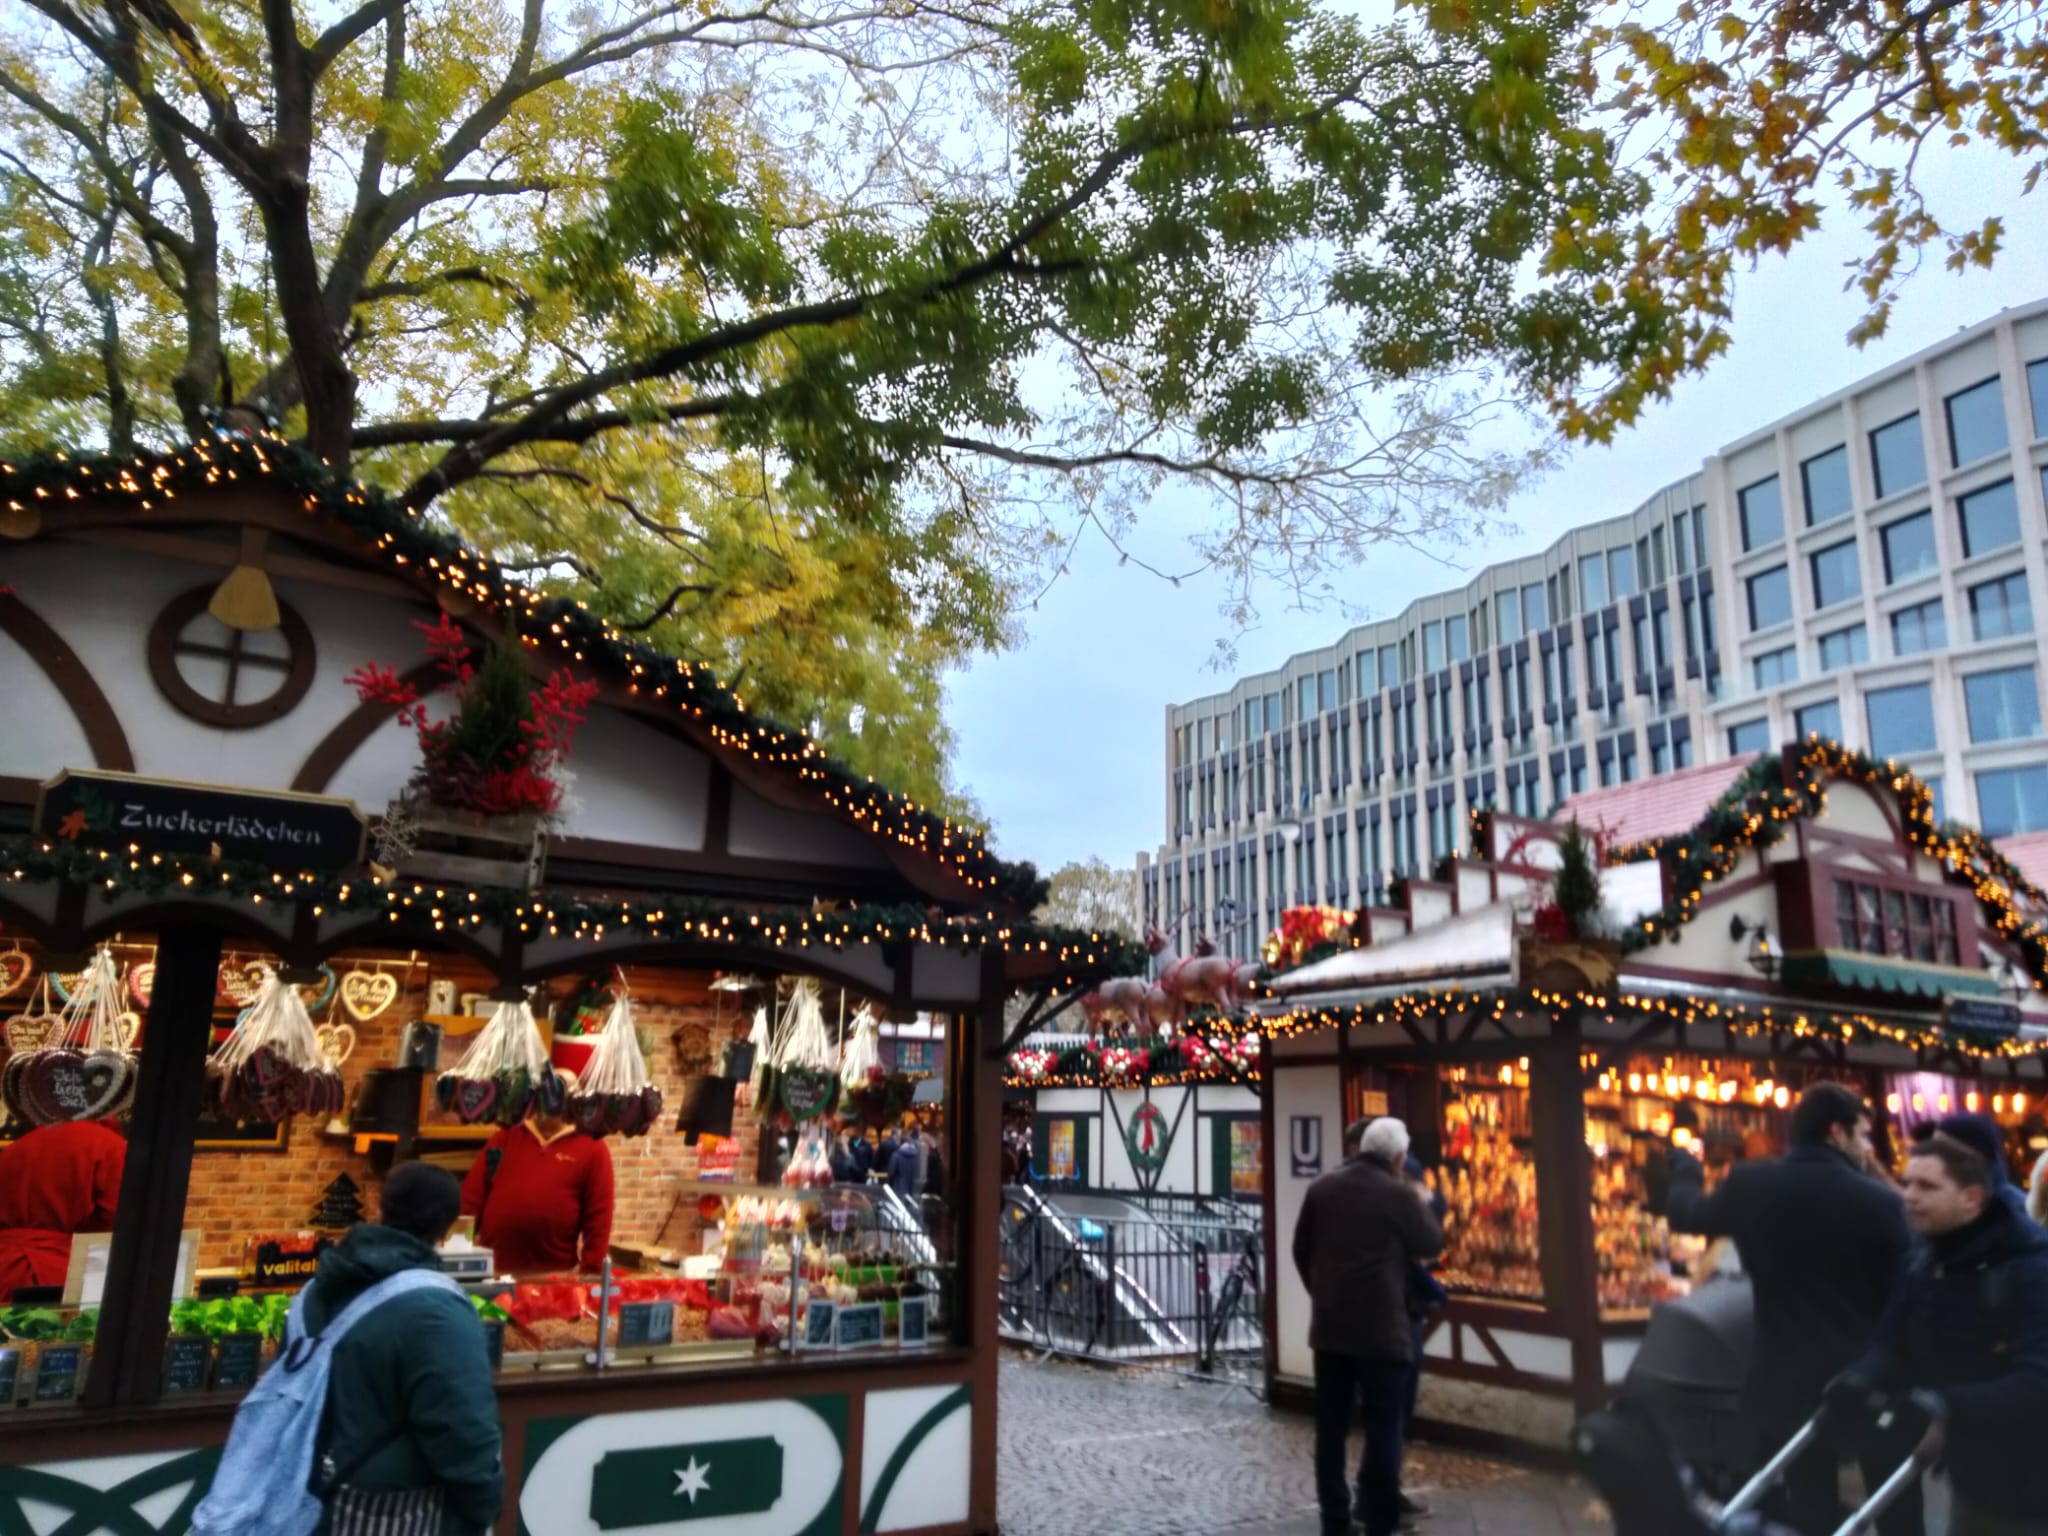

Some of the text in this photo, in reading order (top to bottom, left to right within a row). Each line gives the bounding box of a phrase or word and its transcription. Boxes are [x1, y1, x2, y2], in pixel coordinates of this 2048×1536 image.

[120, 803, 321, 845] Zuckerlädchen
[53, 1068, 83, 1082] Ich
[53, 1083, 86, 1096] liebe
[1294, 1120, 1318, 1163] U
